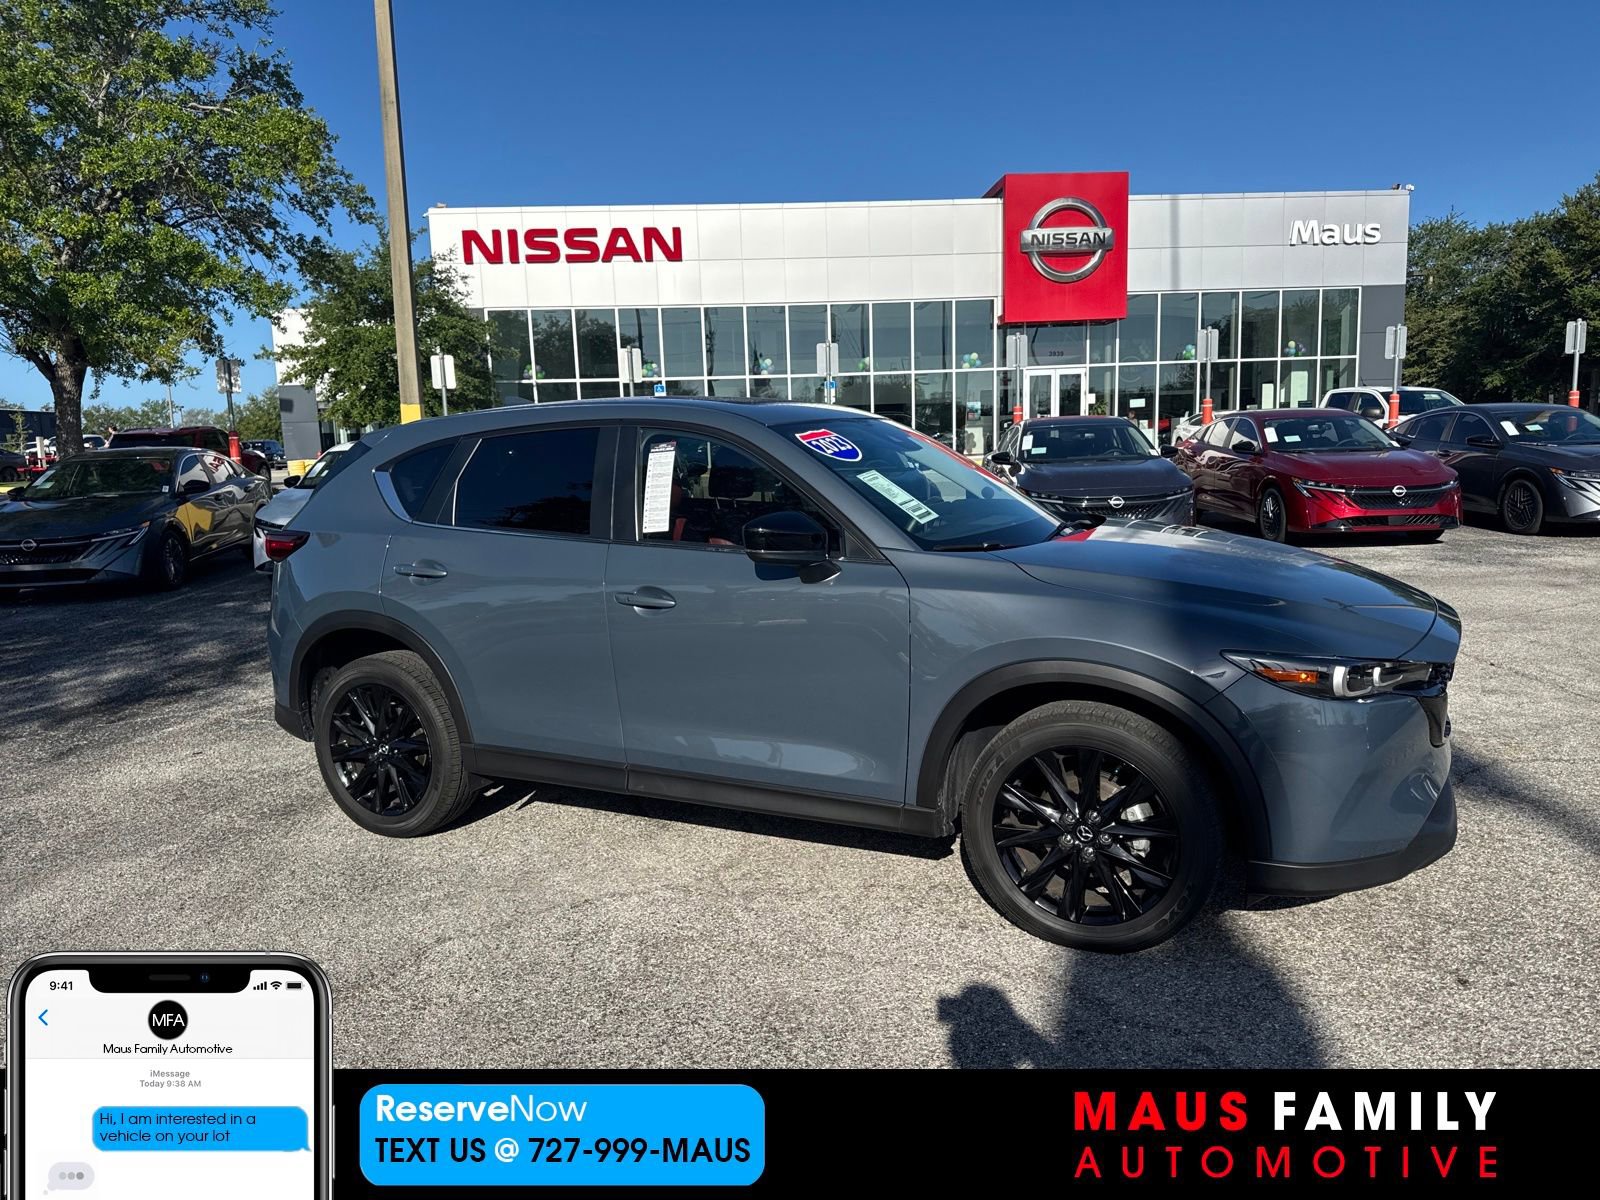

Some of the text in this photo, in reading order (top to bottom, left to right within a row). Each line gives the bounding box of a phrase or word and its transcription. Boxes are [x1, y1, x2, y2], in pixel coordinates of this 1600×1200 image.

[1030, 231, 1106, 247] NISSAN
[1289, 219, 1382, 246] Maus
[461, 227, 683, 265] NISSAN
[812, 435, 852, 455] 2023
